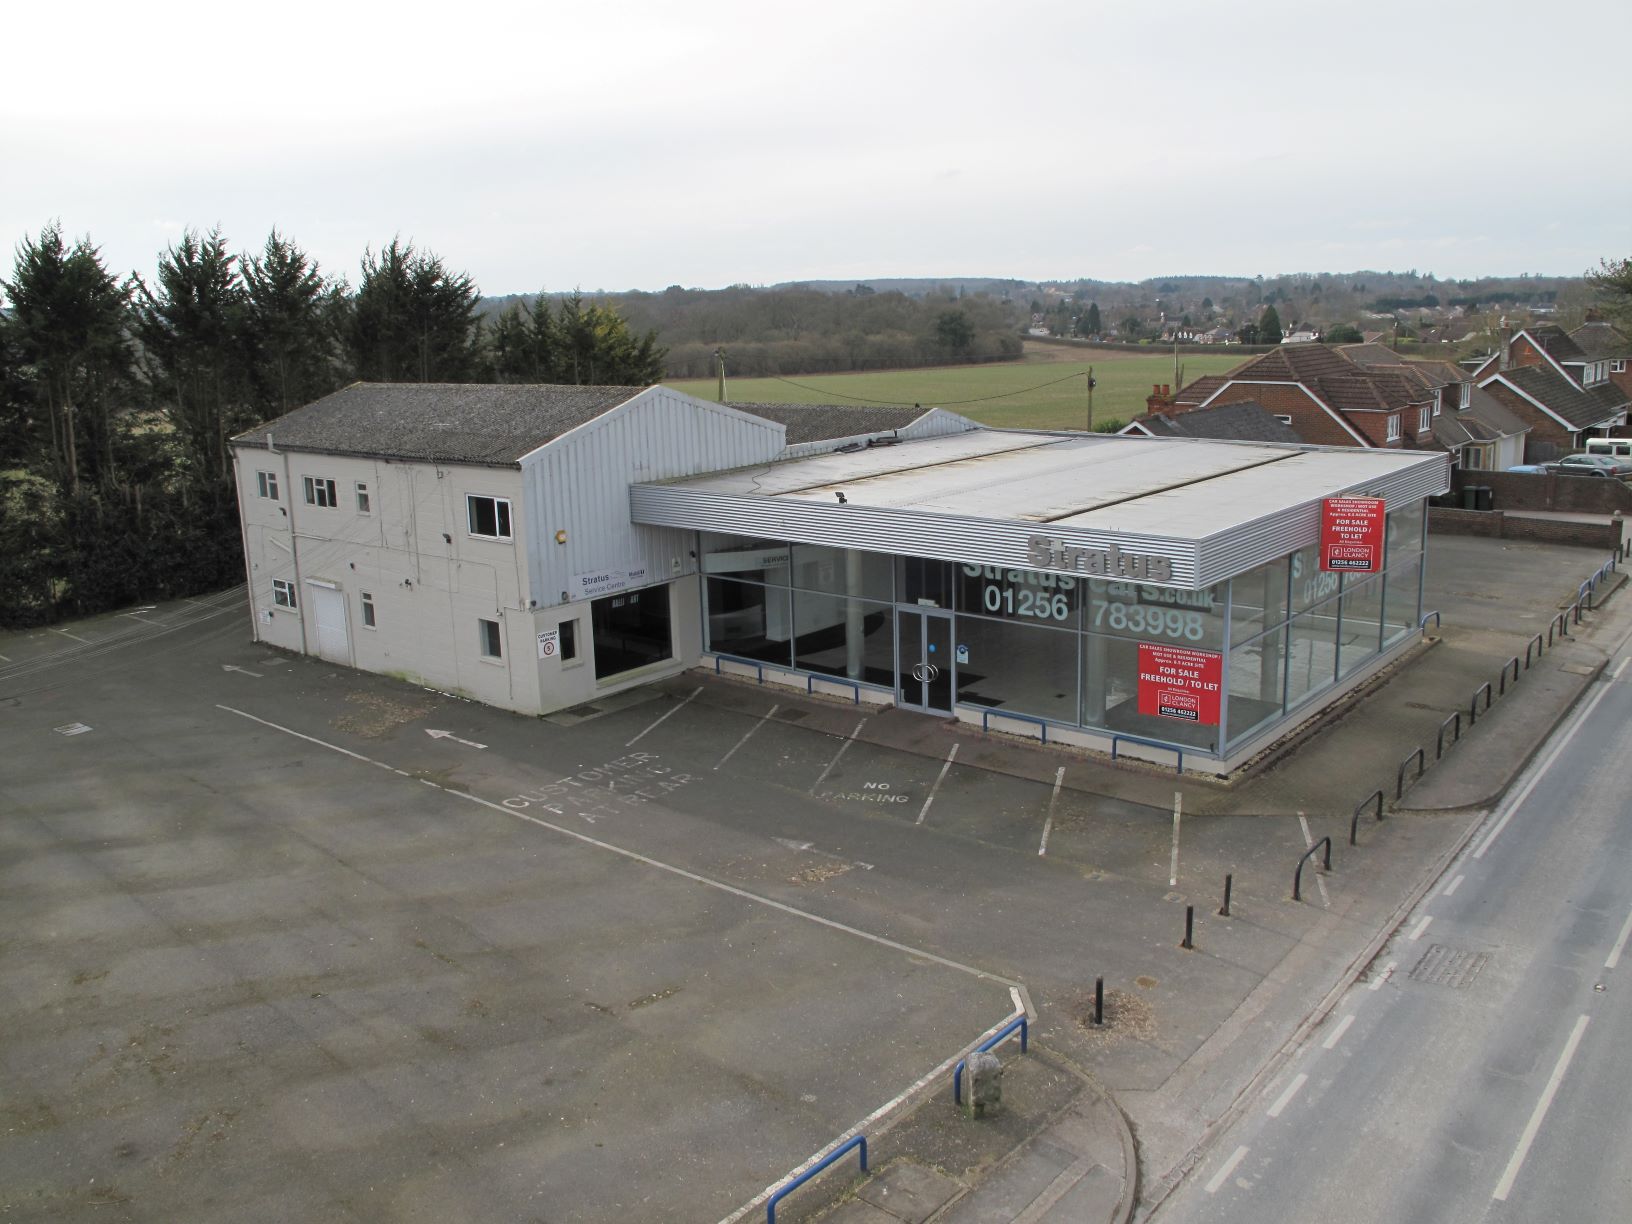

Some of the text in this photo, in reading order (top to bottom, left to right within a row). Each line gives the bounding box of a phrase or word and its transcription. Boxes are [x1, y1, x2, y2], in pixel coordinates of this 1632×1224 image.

[1026, 534, 1172, 581] Stratus
[582, 574, 609, 586] Stratus
[584, 585, 605, 596] Service
[606, 580, 626, 590] Centre
[985, 585, 1204, 640] 01256 783998
[1160, 666, 1199, 678] FOR SALE
[1140, 673, 1184, 686] FREEHOLD
[1191, 680, 1202, 688] TO
[1204, 682, 1218, 691] LET
[502, 752, 660, 808] CUSTOMER
[863, 782, 890, 790] NO
